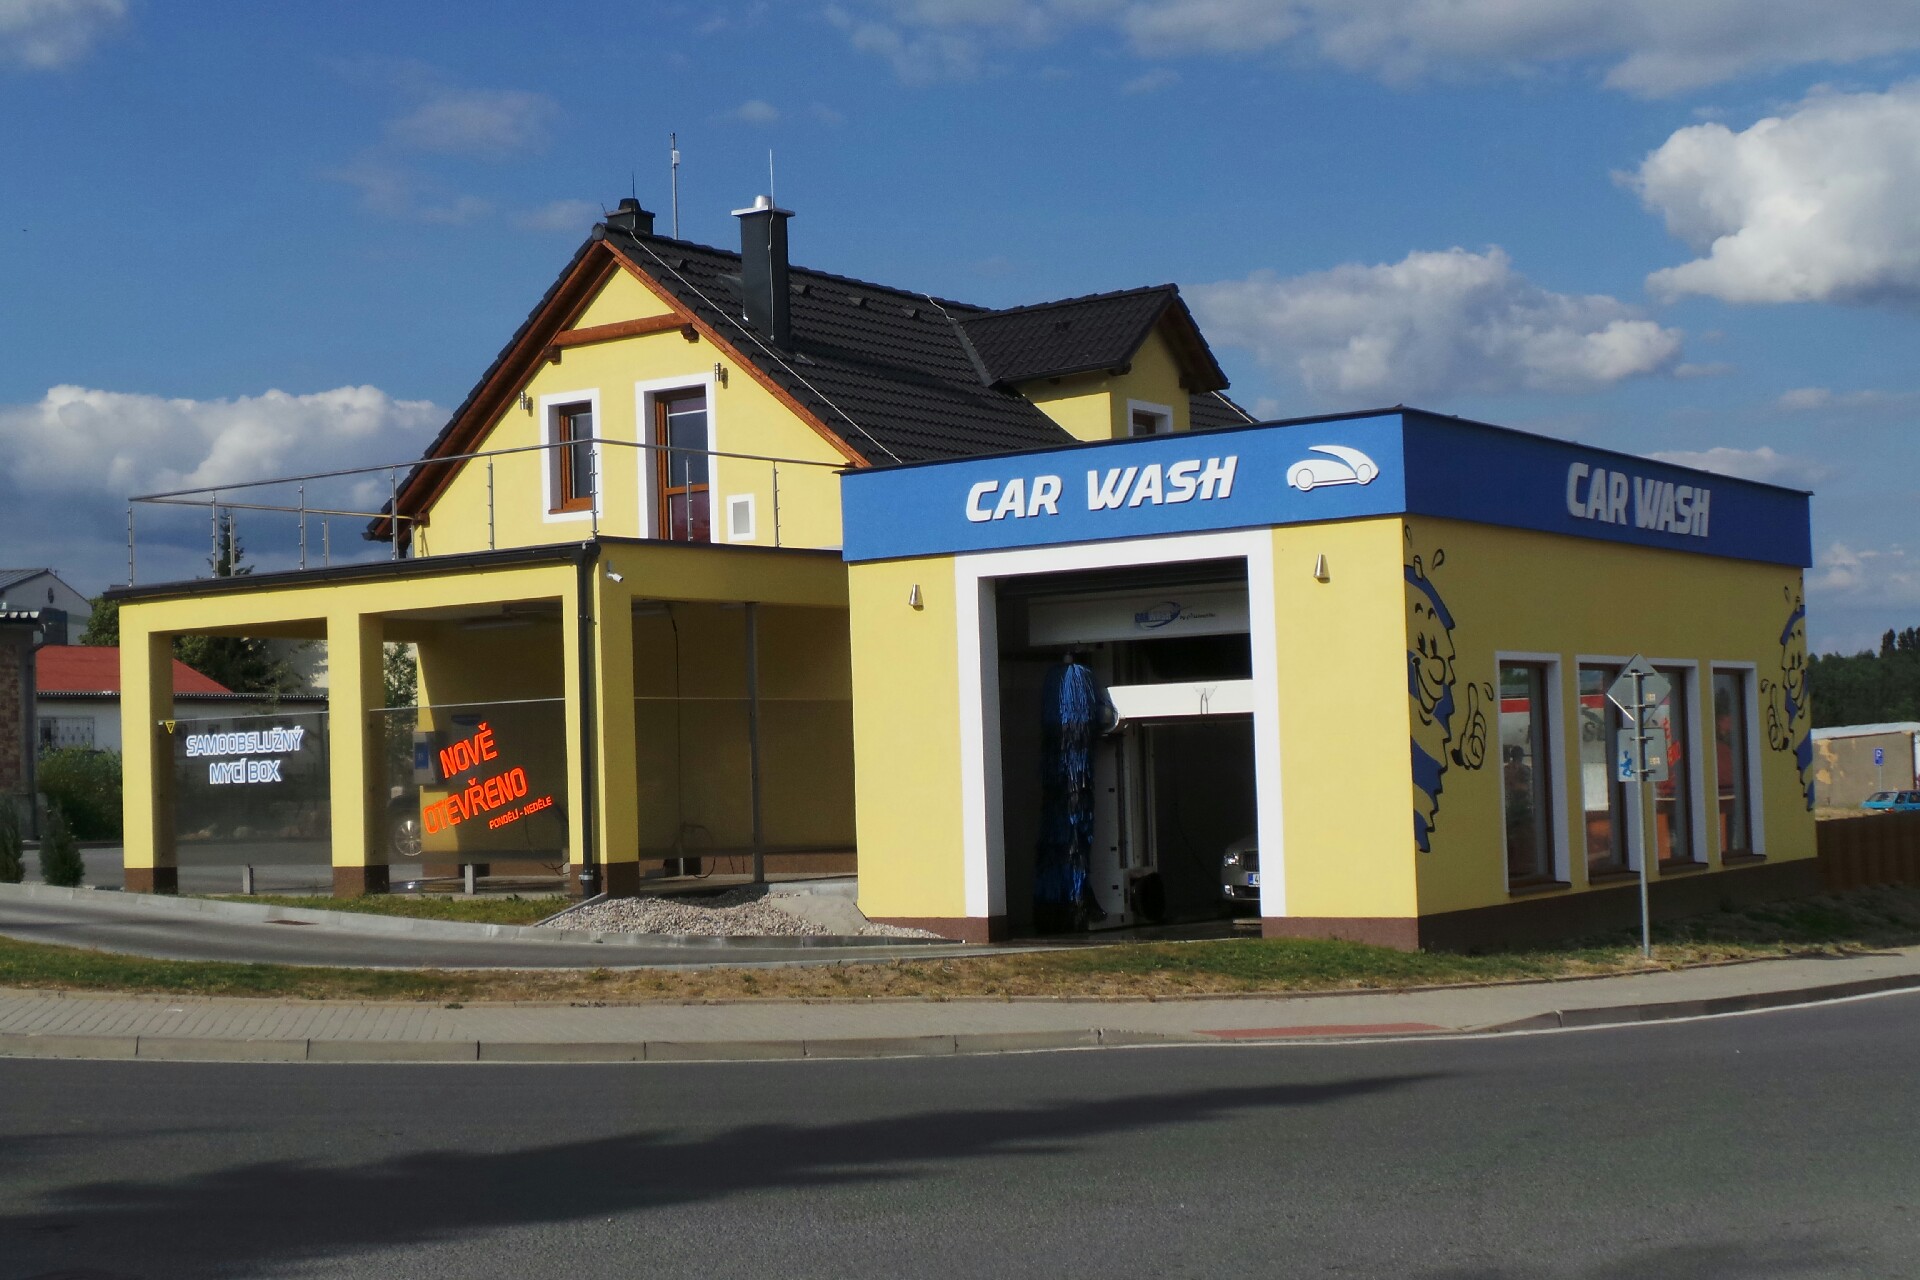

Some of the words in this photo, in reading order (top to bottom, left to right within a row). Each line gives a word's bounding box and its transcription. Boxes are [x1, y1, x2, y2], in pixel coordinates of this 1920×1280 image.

[965, 474, 1063, 523] CAR
[1086, 455, 1239, 511] WASH
[1566, 462, 1629, 527] CAR
[1634, 476, 1711, 538] WASH
[186, 726, 304, 757] SAMOOBSLUŽNÝ
[439, 722, 498, 778] NOVĚ
[209, 758, 247, 785] MYCÍ
[248, 760, 282, 783] BOX
[422, 765, 528, 834] OTEVŘENO
[524, 796, 553, 816] NEDĚLE
